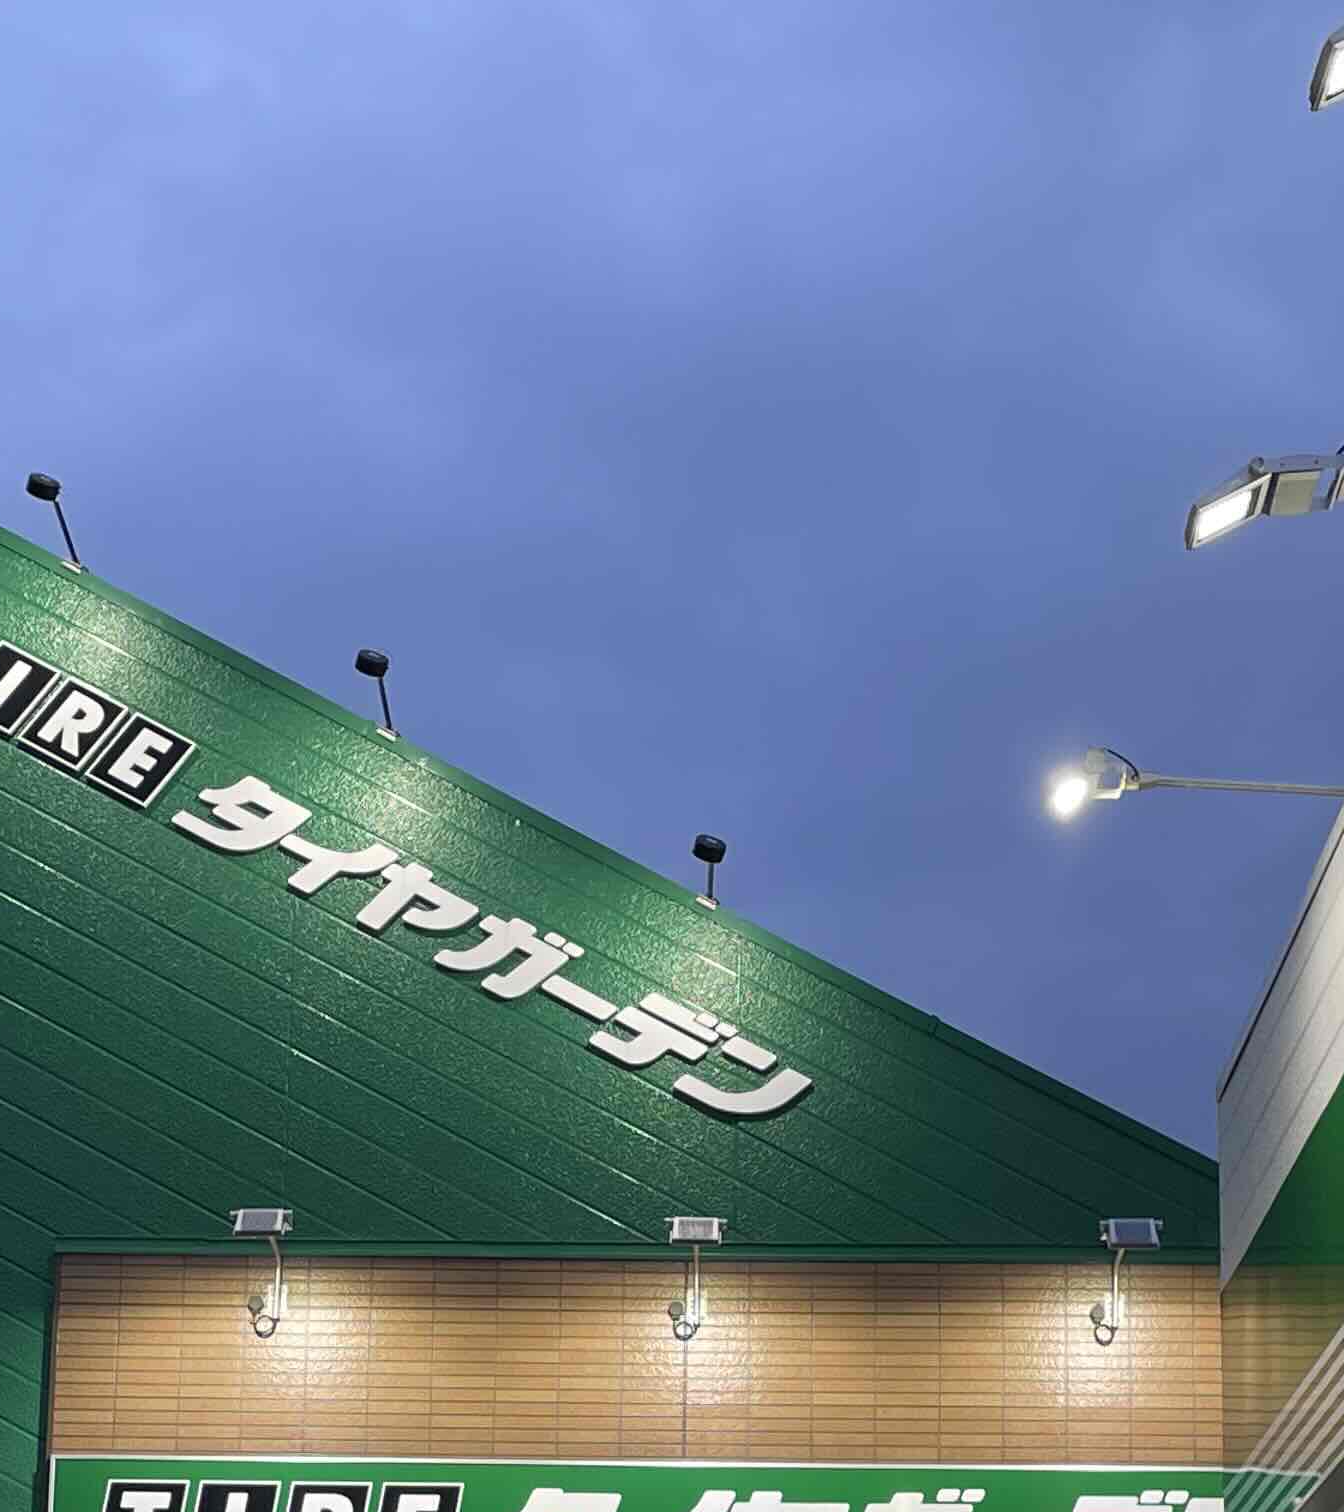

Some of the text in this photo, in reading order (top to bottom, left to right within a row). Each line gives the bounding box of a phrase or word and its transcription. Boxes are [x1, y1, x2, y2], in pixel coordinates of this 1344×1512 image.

[170, 774, 814, 1116] タイヤガーデン
